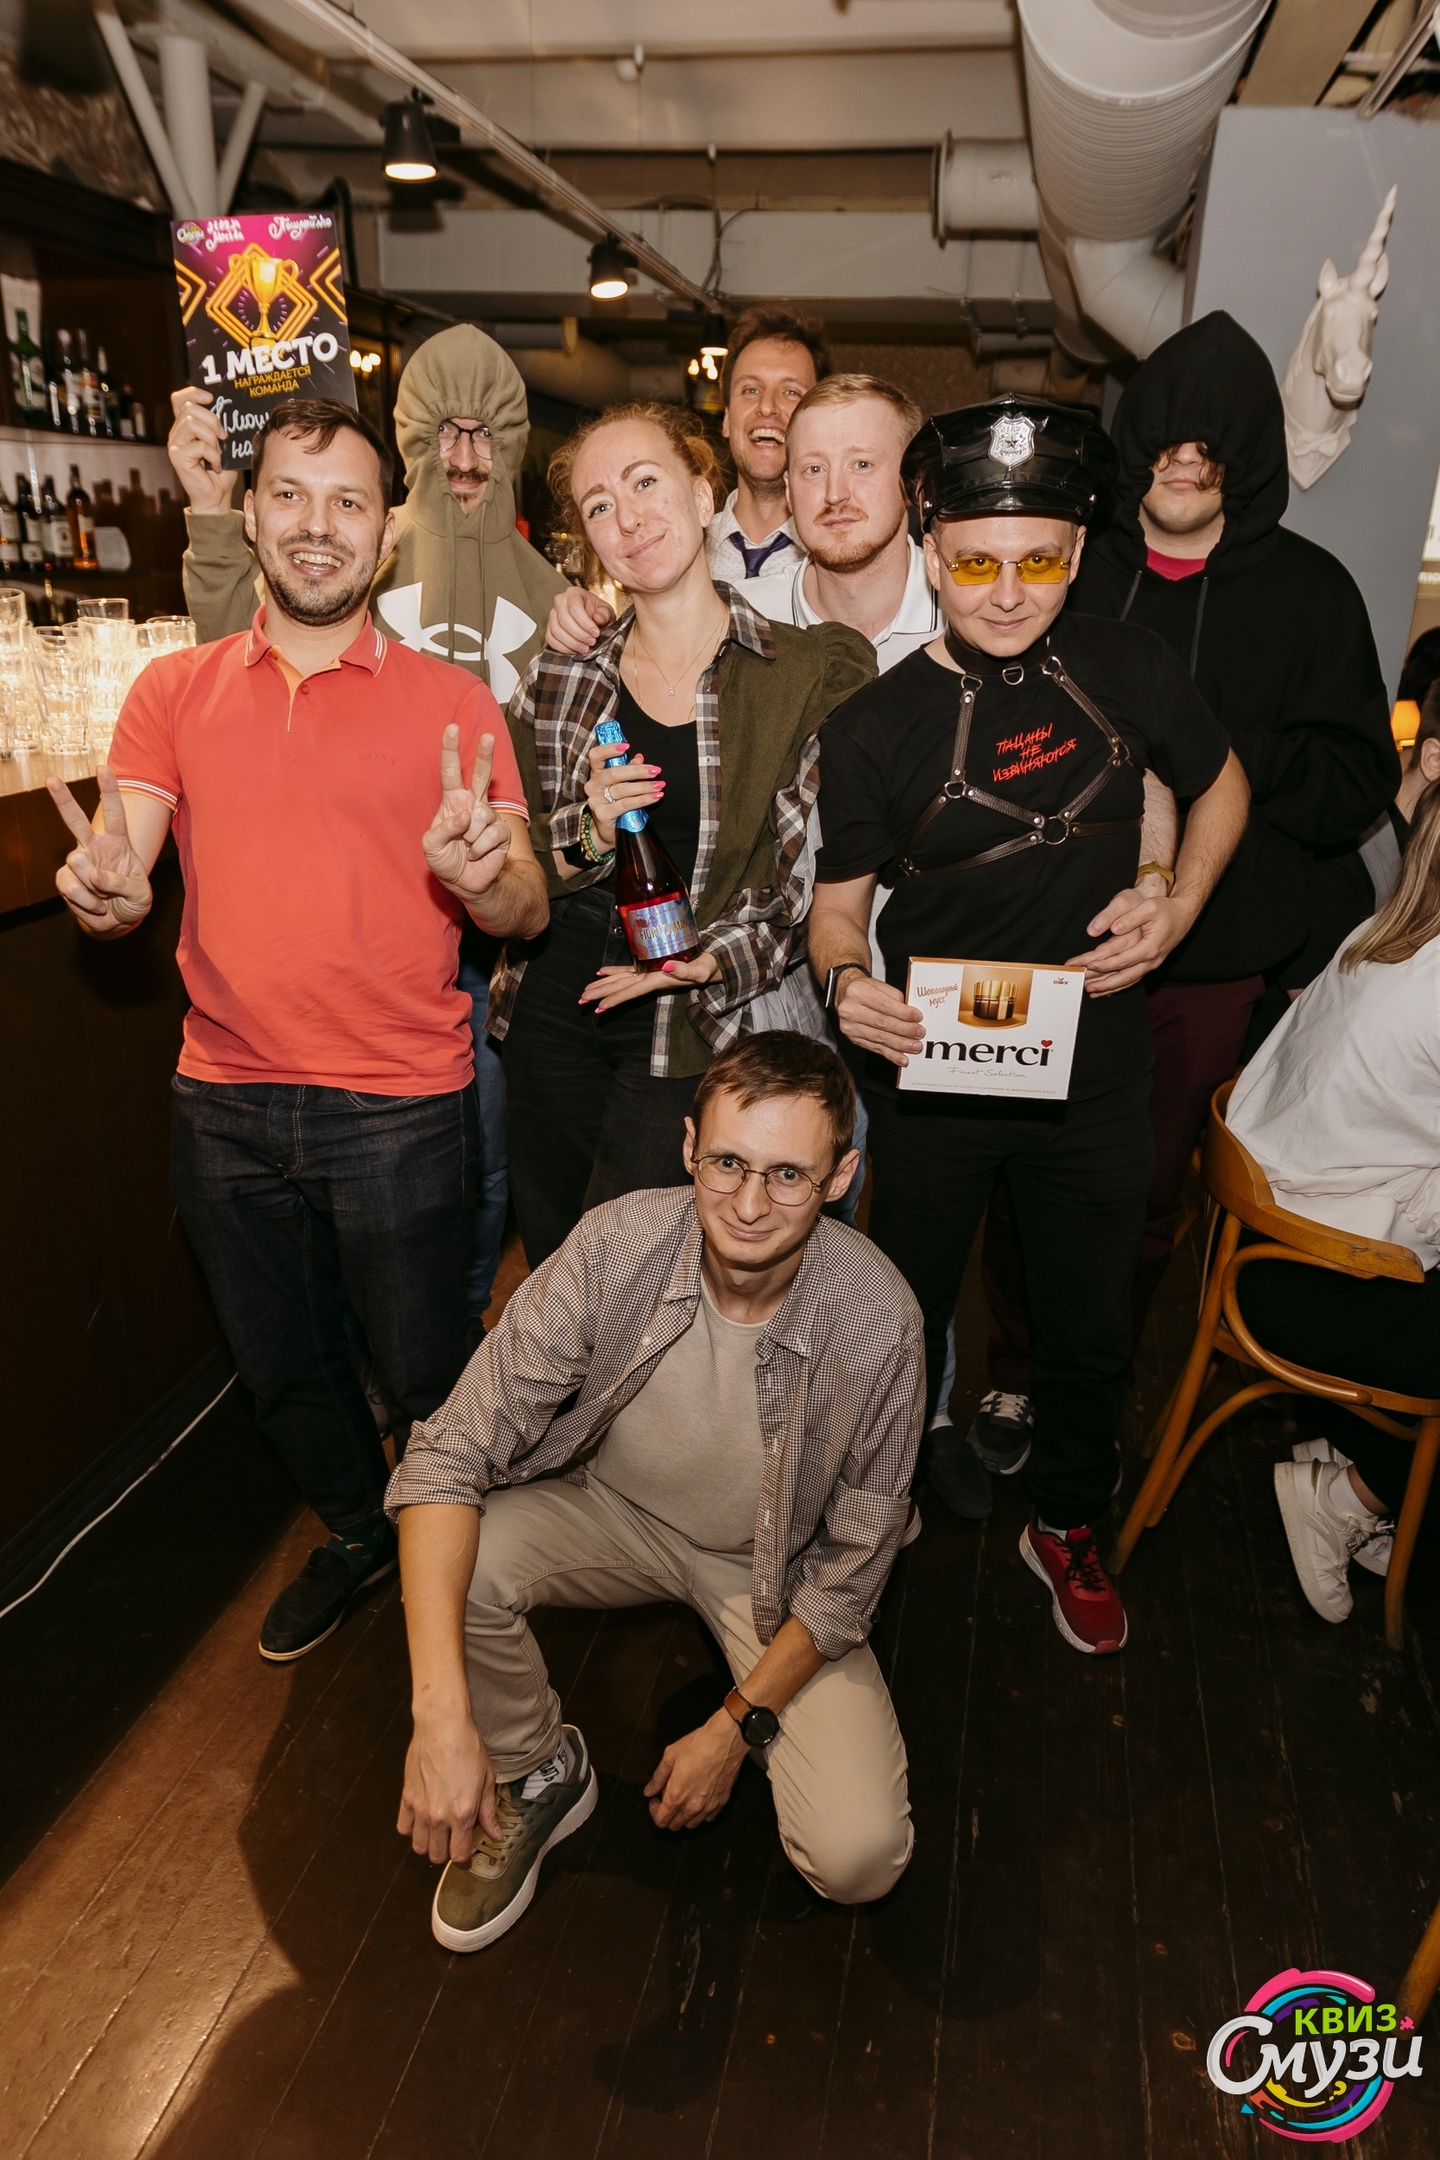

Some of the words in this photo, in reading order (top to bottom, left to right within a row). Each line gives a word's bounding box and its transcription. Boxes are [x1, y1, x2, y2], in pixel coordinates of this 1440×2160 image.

[202, 354, 222, 385] 1
[227, 333, 338, 381] МЕСТО
[234, 366, 311, 389] НАГРАЖДАЕТСЯ
[249, 380, 300, 398] КОМАНДА
[996, 723, 1053, 755] ПАЦАНЫ
[993, 738, 1077, 782] ИЗВИНЯЮТСЯ
[1019, 743, 1042, 760] НЕ
[916, 983, 959, 997] Шоколадный
[929, 996, 946, 1008] мусс
[925, 1039, 1052, 1067] merci
[946, 1066, 983, 1075] Finest
[984, 1068, 1028, 1078] Selection
